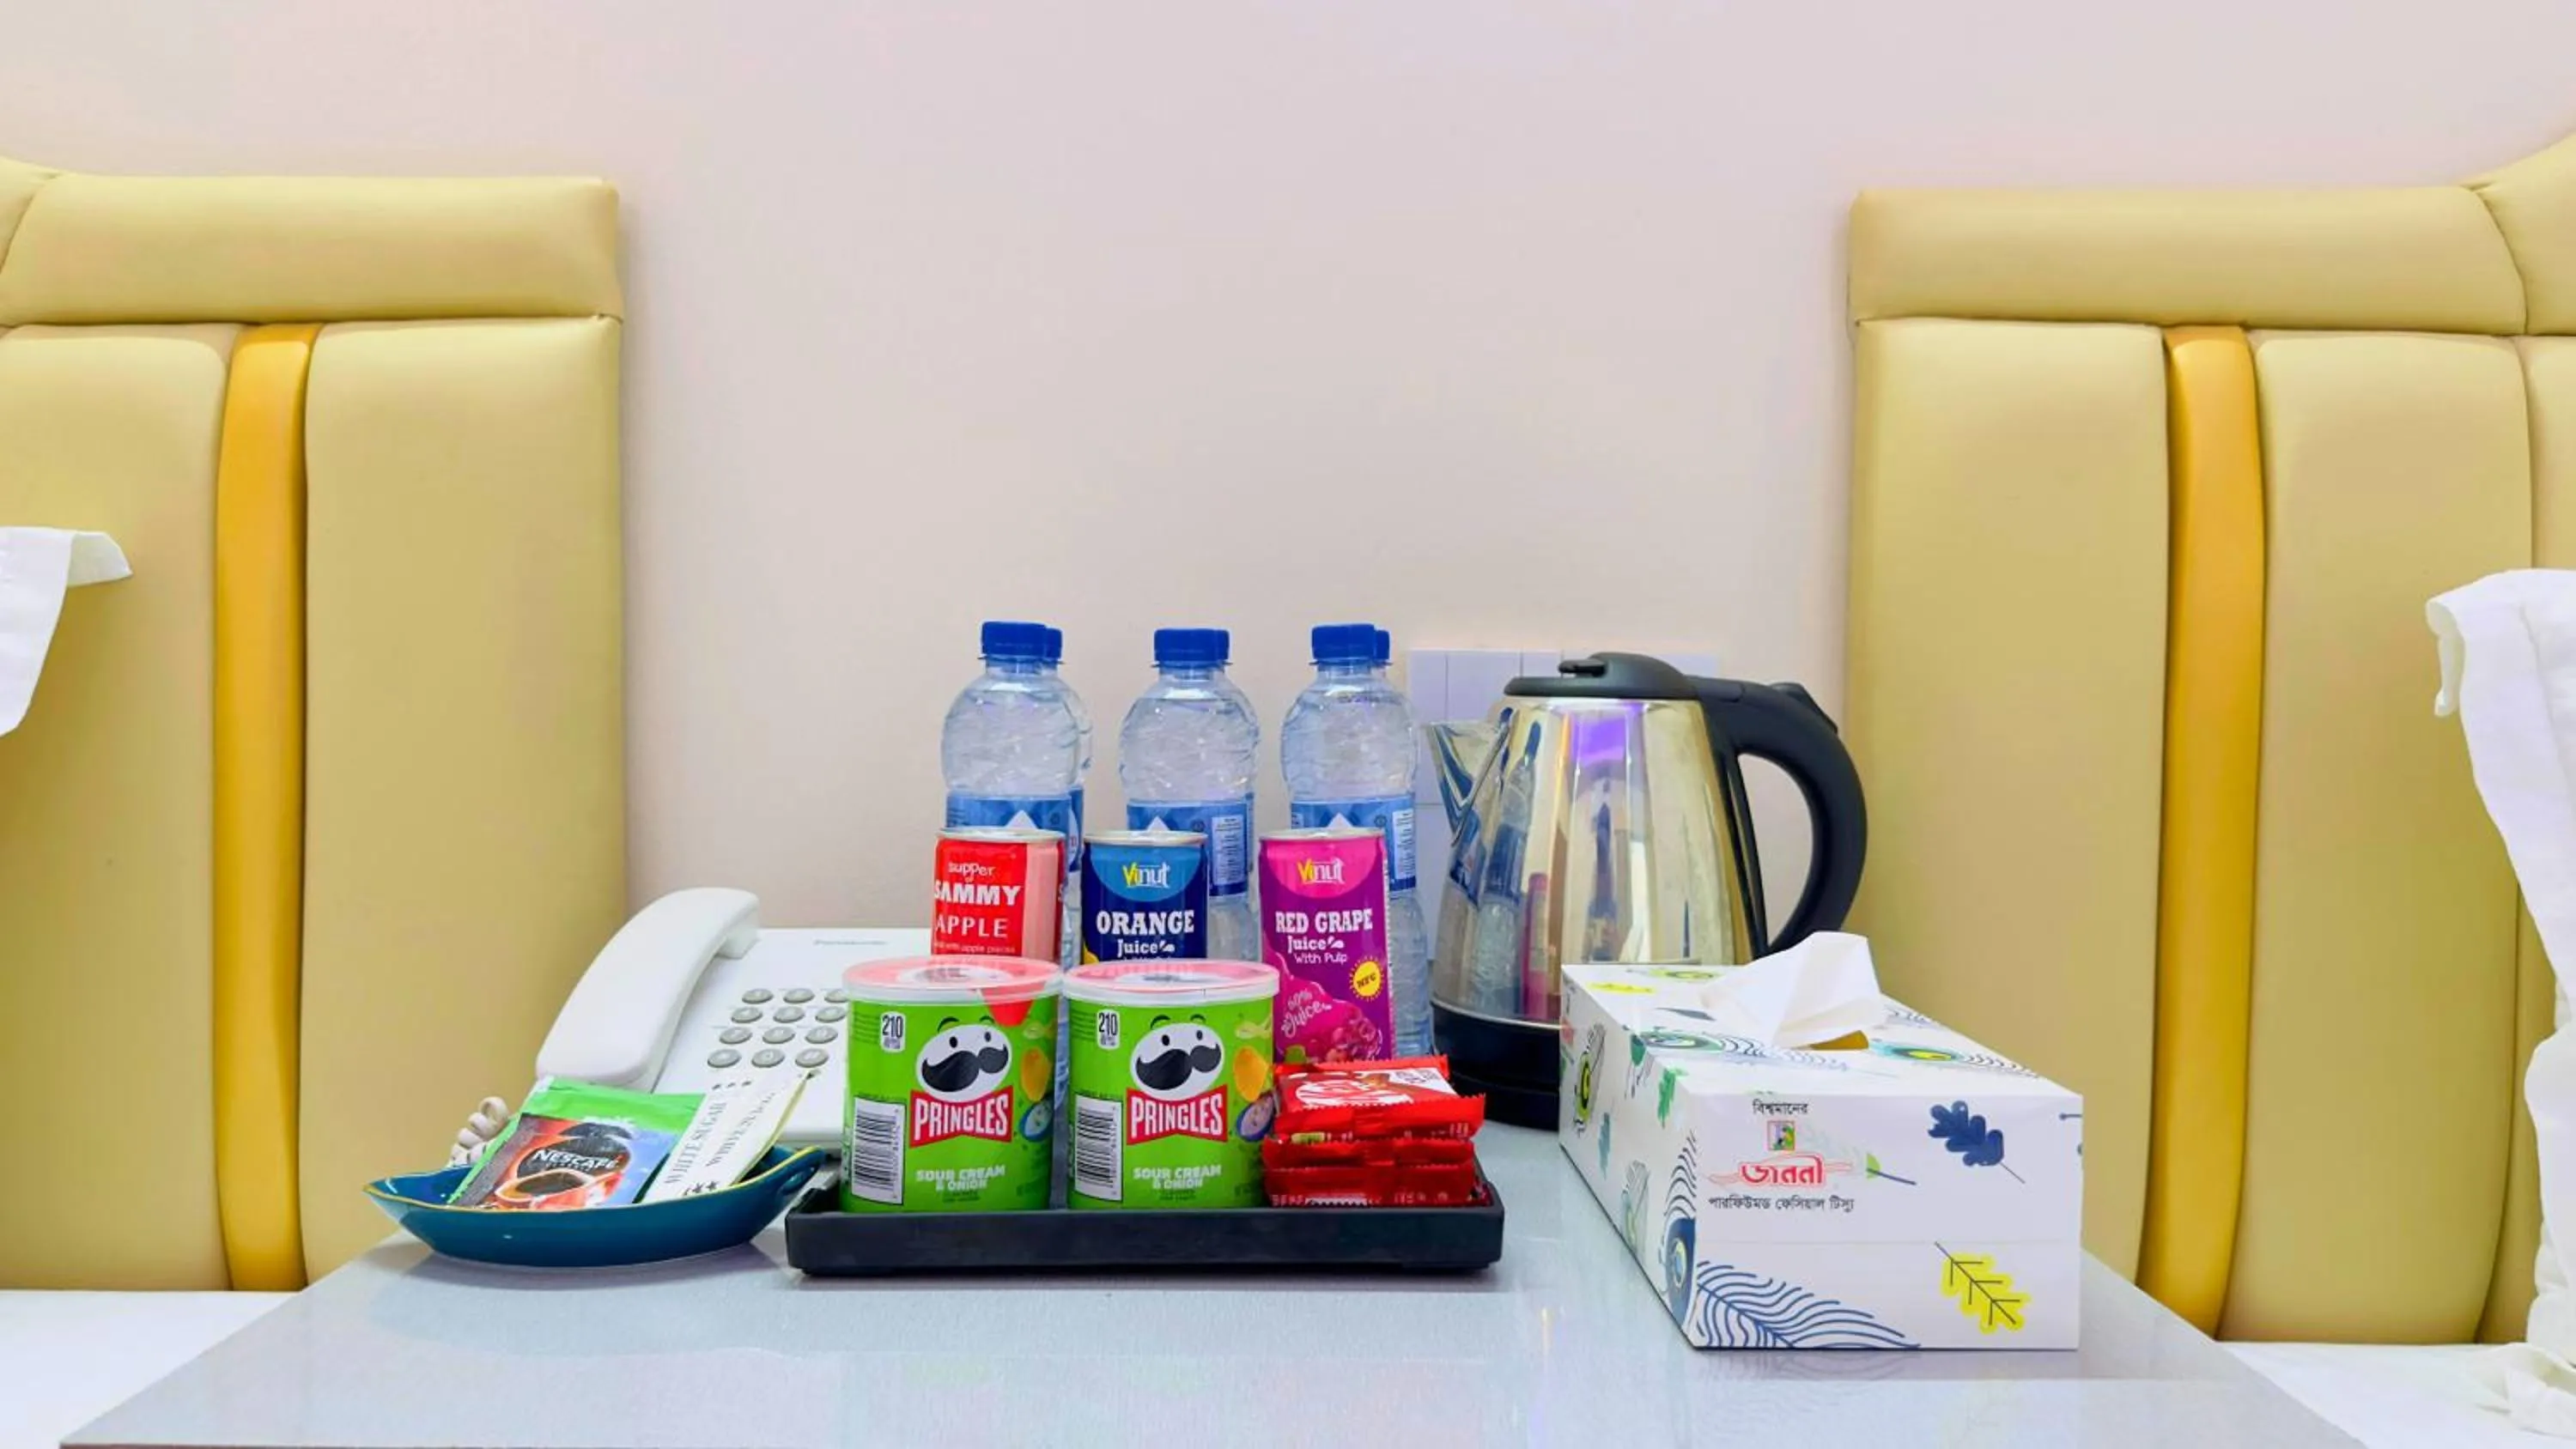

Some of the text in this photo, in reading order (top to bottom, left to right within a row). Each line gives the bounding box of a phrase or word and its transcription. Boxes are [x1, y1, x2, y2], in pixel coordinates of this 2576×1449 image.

[1122, 861, 1170, 888] Vinut
[1297, 857, 1346, 885] Vinut
[934, 881, 1021, 906] SAMMY
[936, 914, 1008, 938] APPLE
[1096, 910, 1194, 935] ORANGE
[1275, 908, 1374, 933] RED GRAPE
[1117, 938, 1158, 958] Juice
[1287, 935, 1327, 954] Juice
[882, 1015, 904, 1039] 210
[1098, 1012, 1118, 1036] 210
[913, 1094, 1008, 1142] PRINGLES
[1130, 1092, 1223, 1139] PRINGLES
[915, 1165, 1005, 1182] SOUR CREAM
[1133, 1165, 1222, 1179] SOUR CREAM
[947, 1179, 987, 1191] ONION
[1163, 1179, 1203, 1190] ONION
